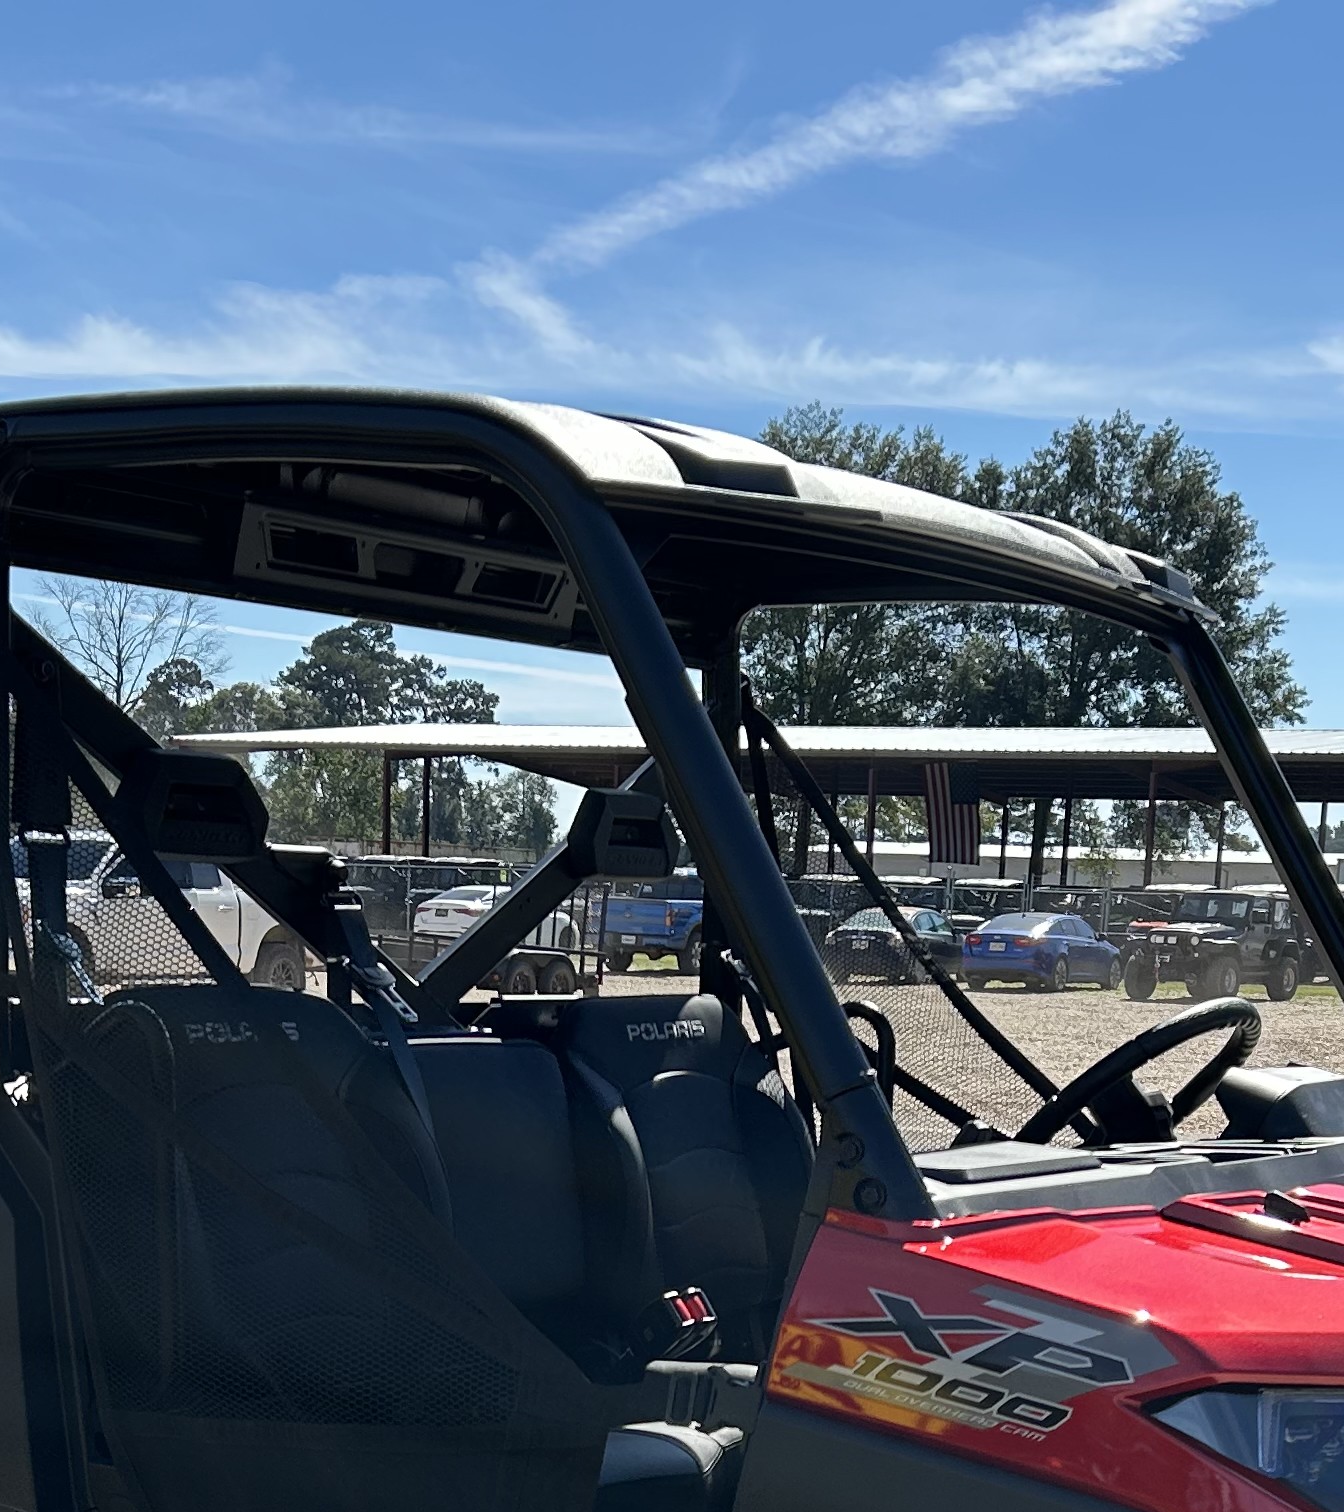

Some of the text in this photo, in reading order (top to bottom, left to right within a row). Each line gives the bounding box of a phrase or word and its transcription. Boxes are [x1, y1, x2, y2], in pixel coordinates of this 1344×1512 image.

[184, 1021, 300, 1043] POLAS
[626, 1019, 705, 1041] POLARIS
[803, 1287, 1135, 1387] XP
[842, 1380, 1047, 1443] DUAL OVERHEAD CAM
[851, 1350, 1074, 1432] 1000
